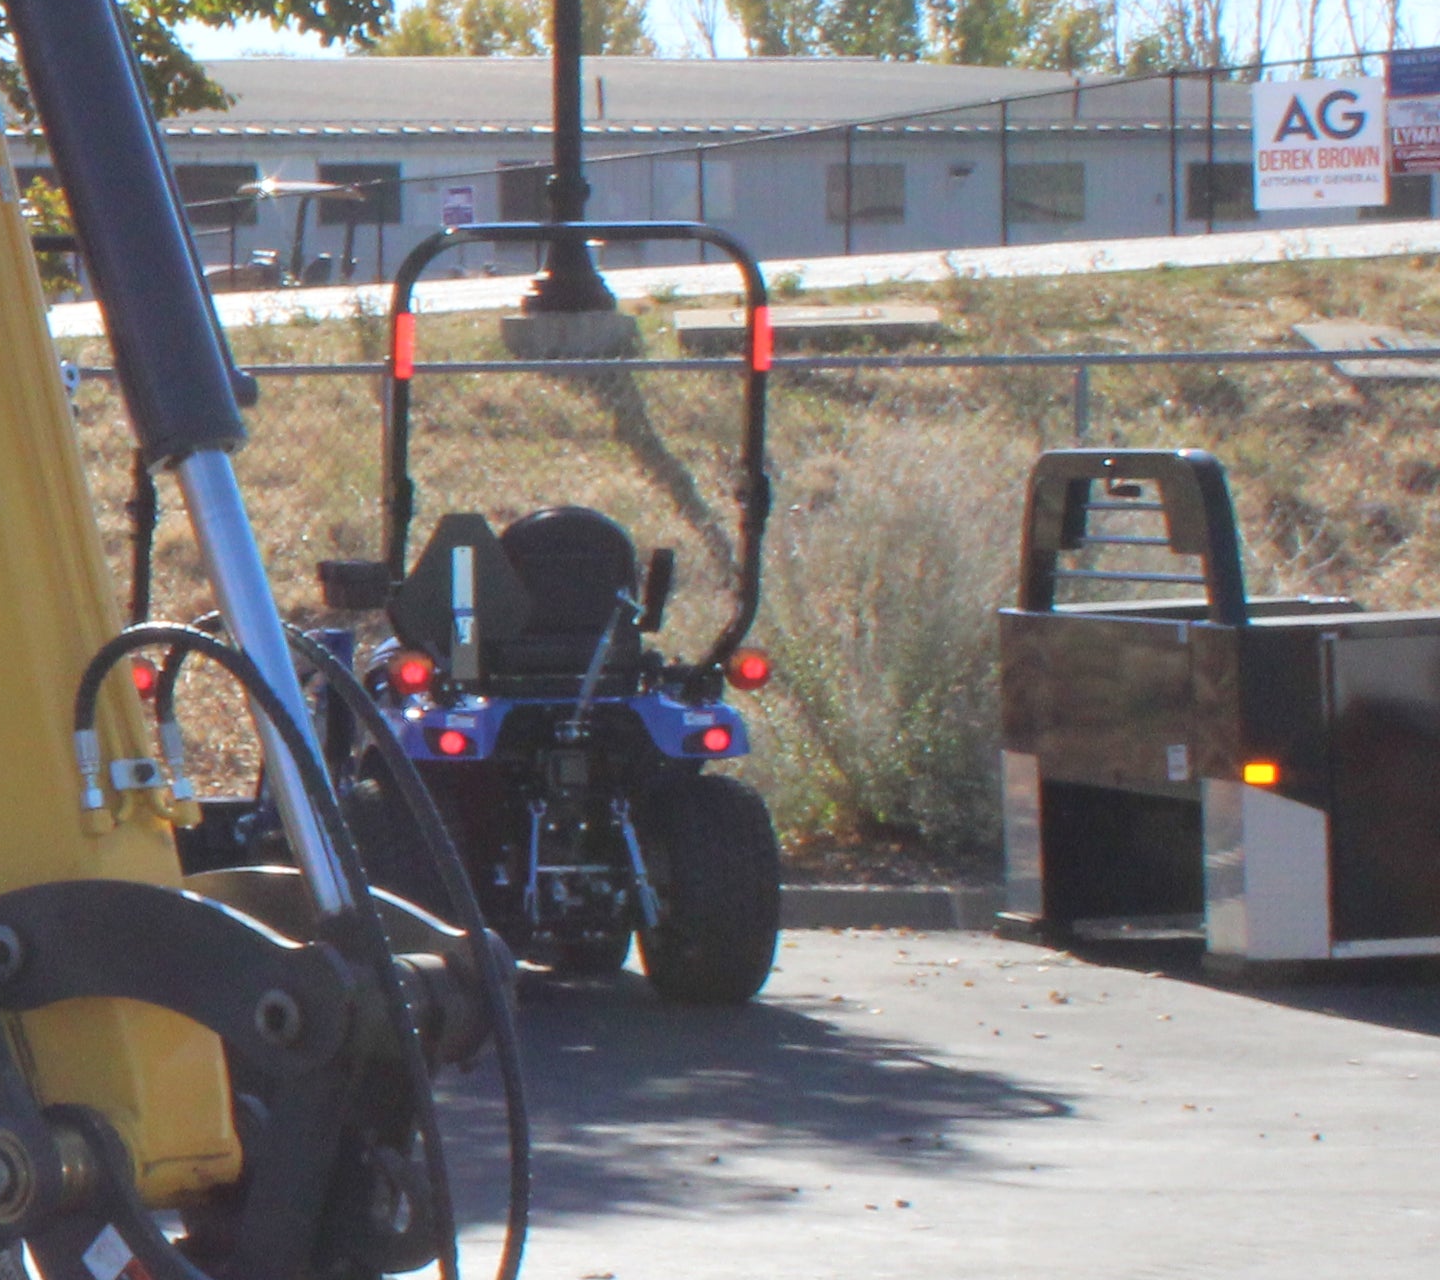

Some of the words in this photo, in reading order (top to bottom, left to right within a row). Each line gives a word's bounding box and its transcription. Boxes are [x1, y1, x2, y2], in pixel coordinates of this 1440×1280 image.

[1273, 89, 1367, 143] AG
[1258, 149, 1314, 172] DEREK
[1317, 146, 1380, 169] BROWN
[1260, 174, 1321, 188] ATTORNEY
[1323, 172, 1380, 185] GENERAL
